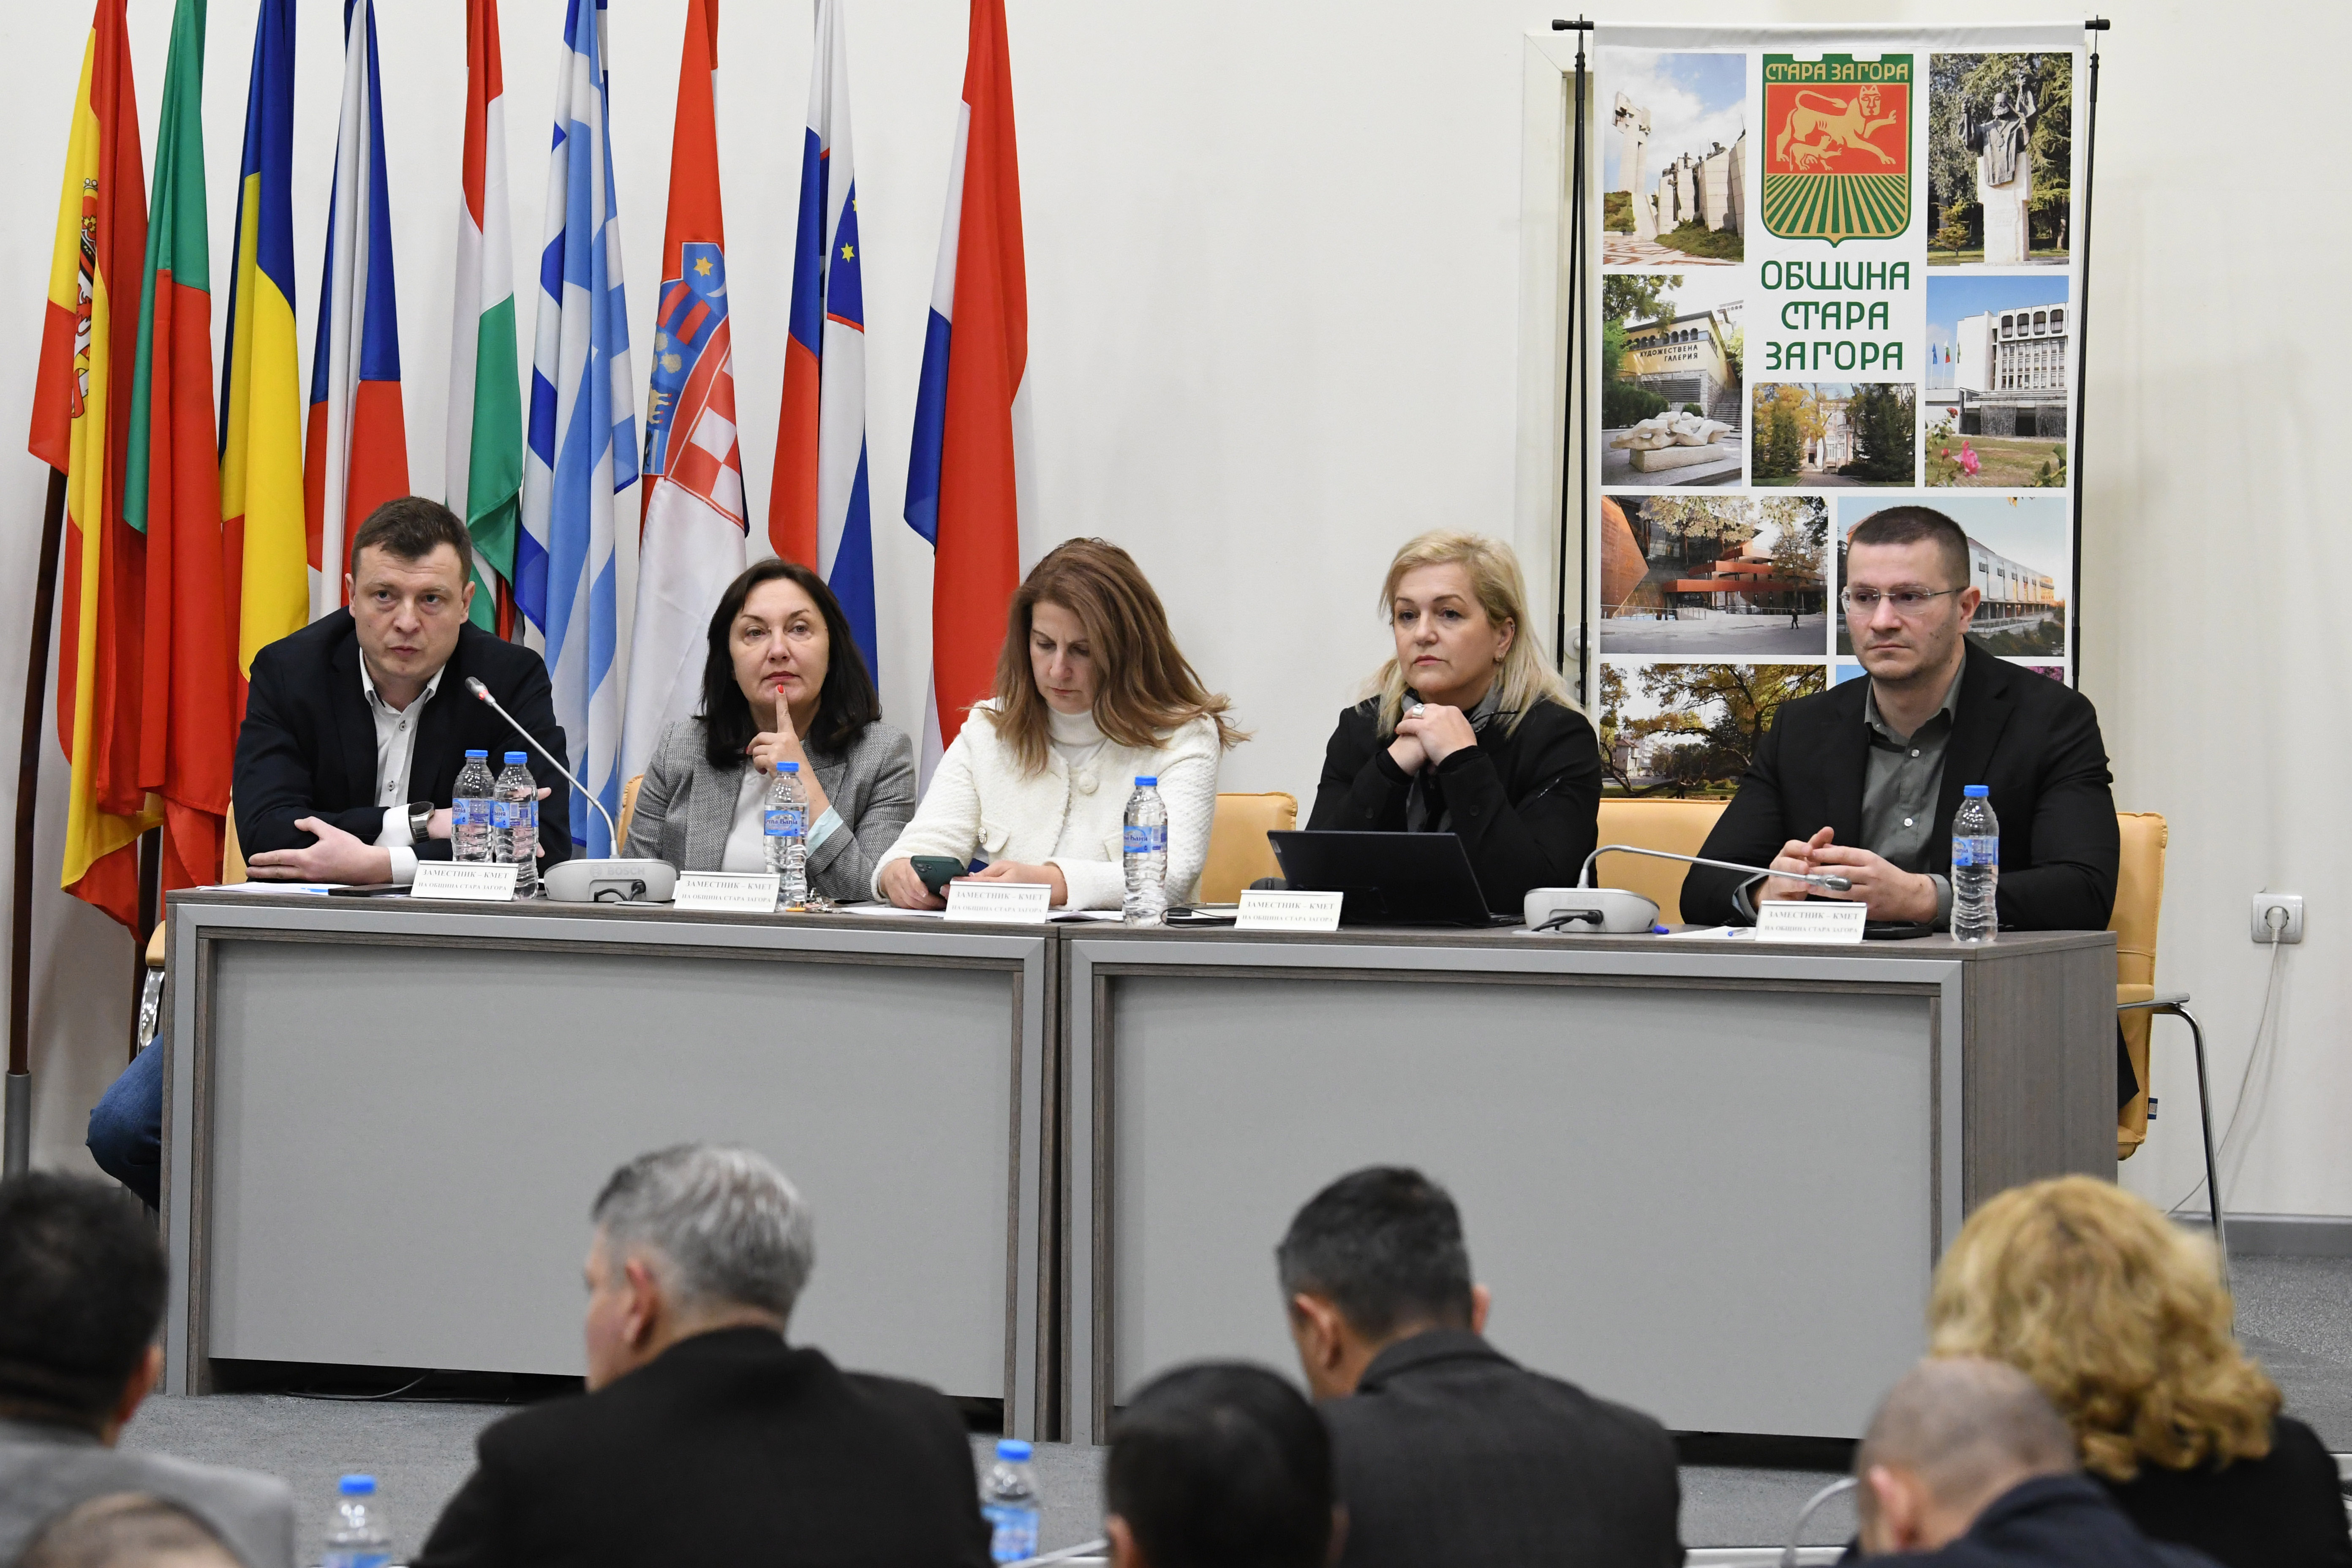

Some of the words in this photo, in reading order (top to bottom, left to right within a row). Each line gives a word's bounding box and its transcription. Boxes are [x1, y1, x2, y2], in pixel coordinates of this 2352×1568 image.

[1766, 63, 1826, 80] СТАРА
[1831, 63, 1908, 80] ЗАГОРА
[1761, 260, 1909, 290] ОБЩИНА
[1781, 302, 1889, 330] СТАРА
[1640, 345, 1698, 357] ХУДОЖЕСТВЕНА
[1766, 341, 1903, 370] ЗАГОРА
[1664, 353, 1698, 362] ГАЛЕРИЯ
[422, 869, 476, 877] ЗАМЕСТНИК
[608, 867, 645, 875] BOSCH
[686, 880, 740, 889] ЗАМЕСТНИК
[956, 891, 1010, 899] ЗАМЕСТНИК
